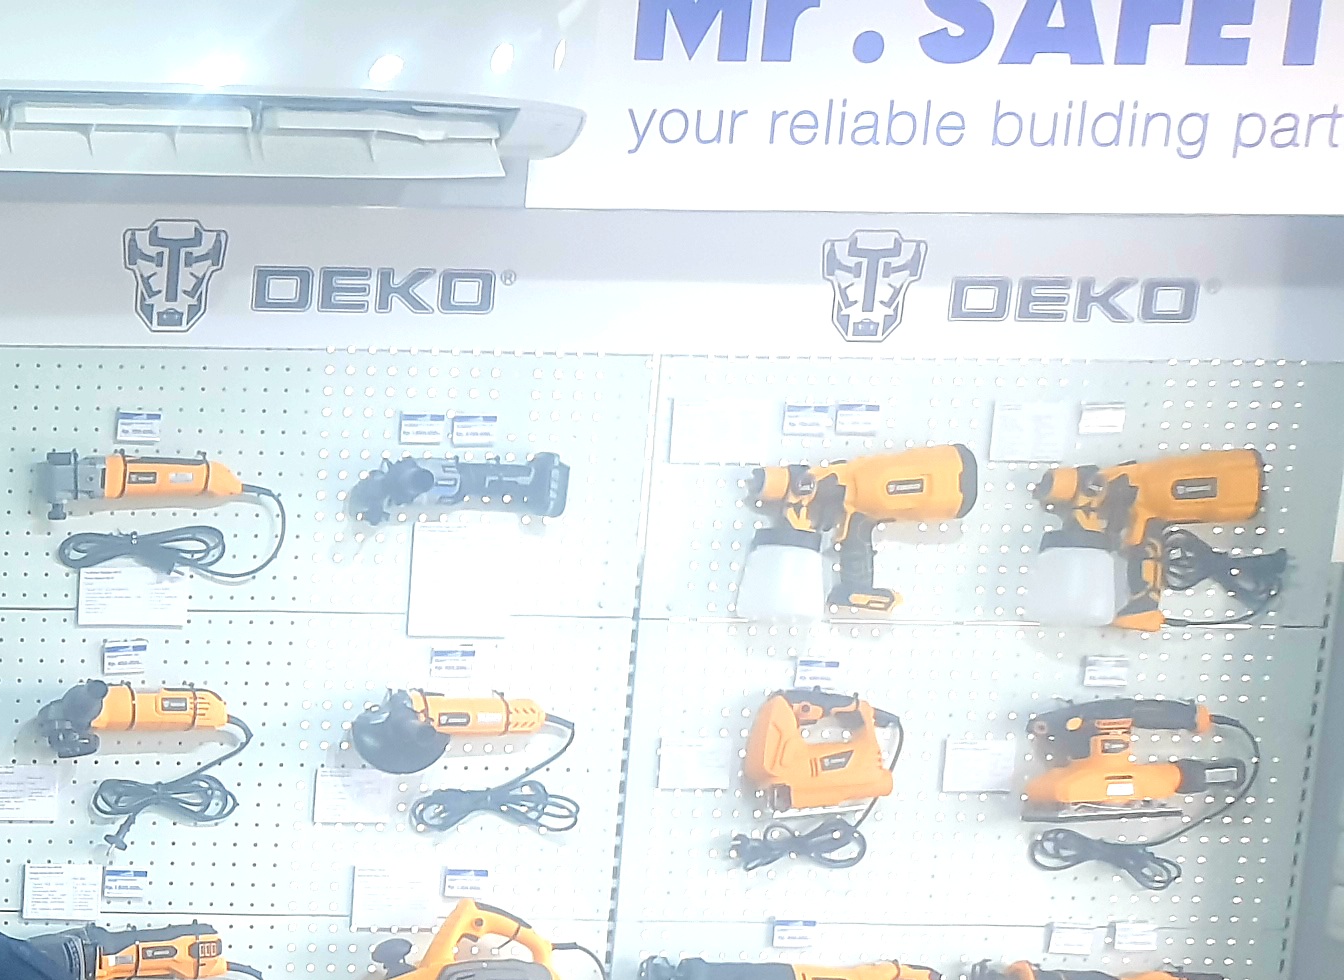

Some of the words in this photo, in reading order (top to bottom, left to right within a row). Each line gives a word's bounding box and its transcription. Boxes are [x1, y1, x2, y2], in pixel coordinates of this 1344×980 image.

[627, 105, 748, 155] your
[769, 98, 965, 147] reliable
[992, 100, 1209, 160] building
